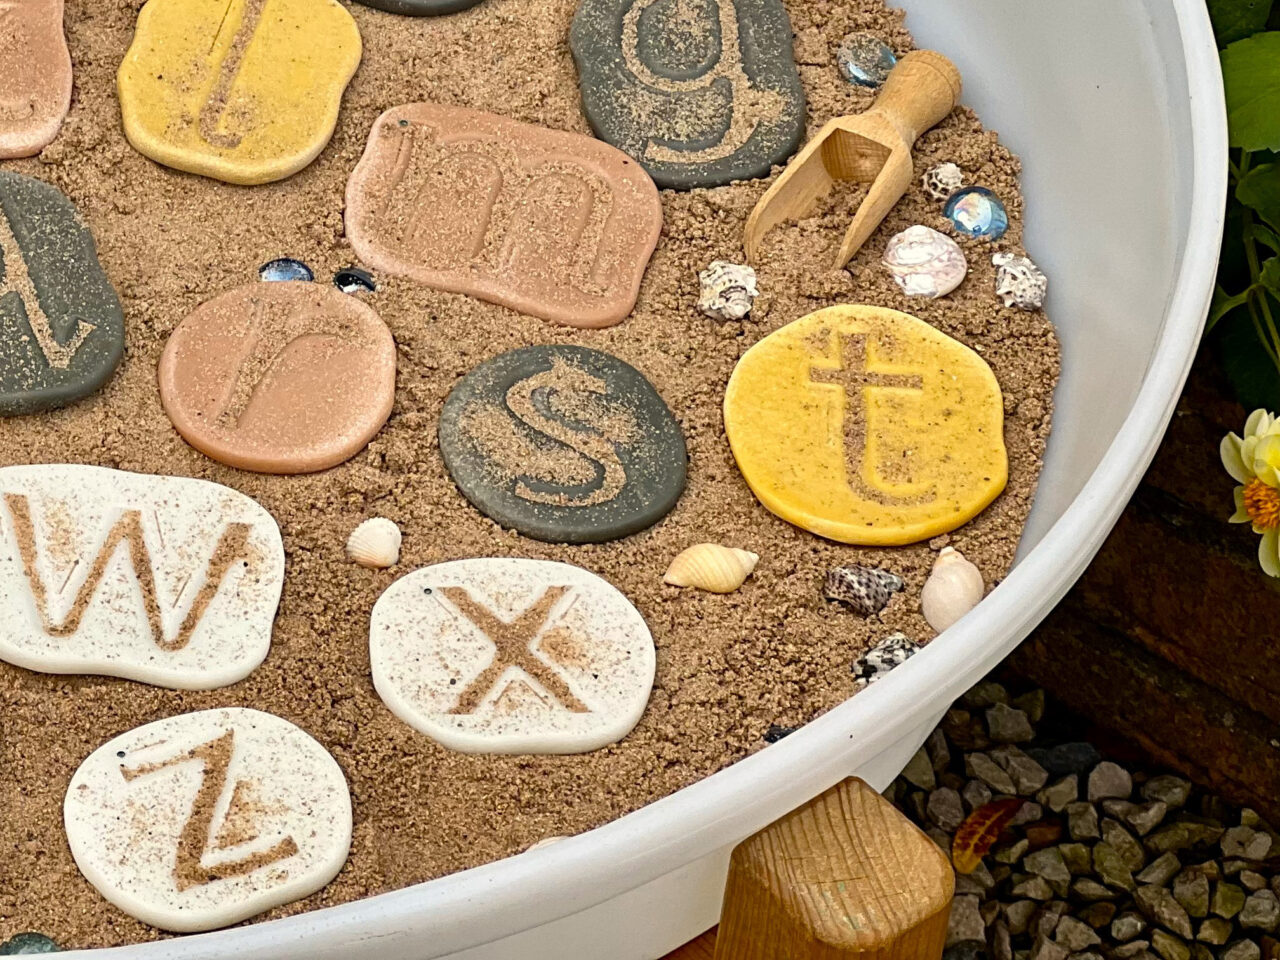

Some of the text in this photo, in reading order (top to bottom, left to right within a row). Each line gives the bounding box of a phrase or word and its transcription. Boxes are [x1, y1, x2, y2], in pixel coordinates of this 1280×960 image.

[377, 123, 614, 295] m
[217, 302, 375, 429] r
[809, 332, 937, 507] t
